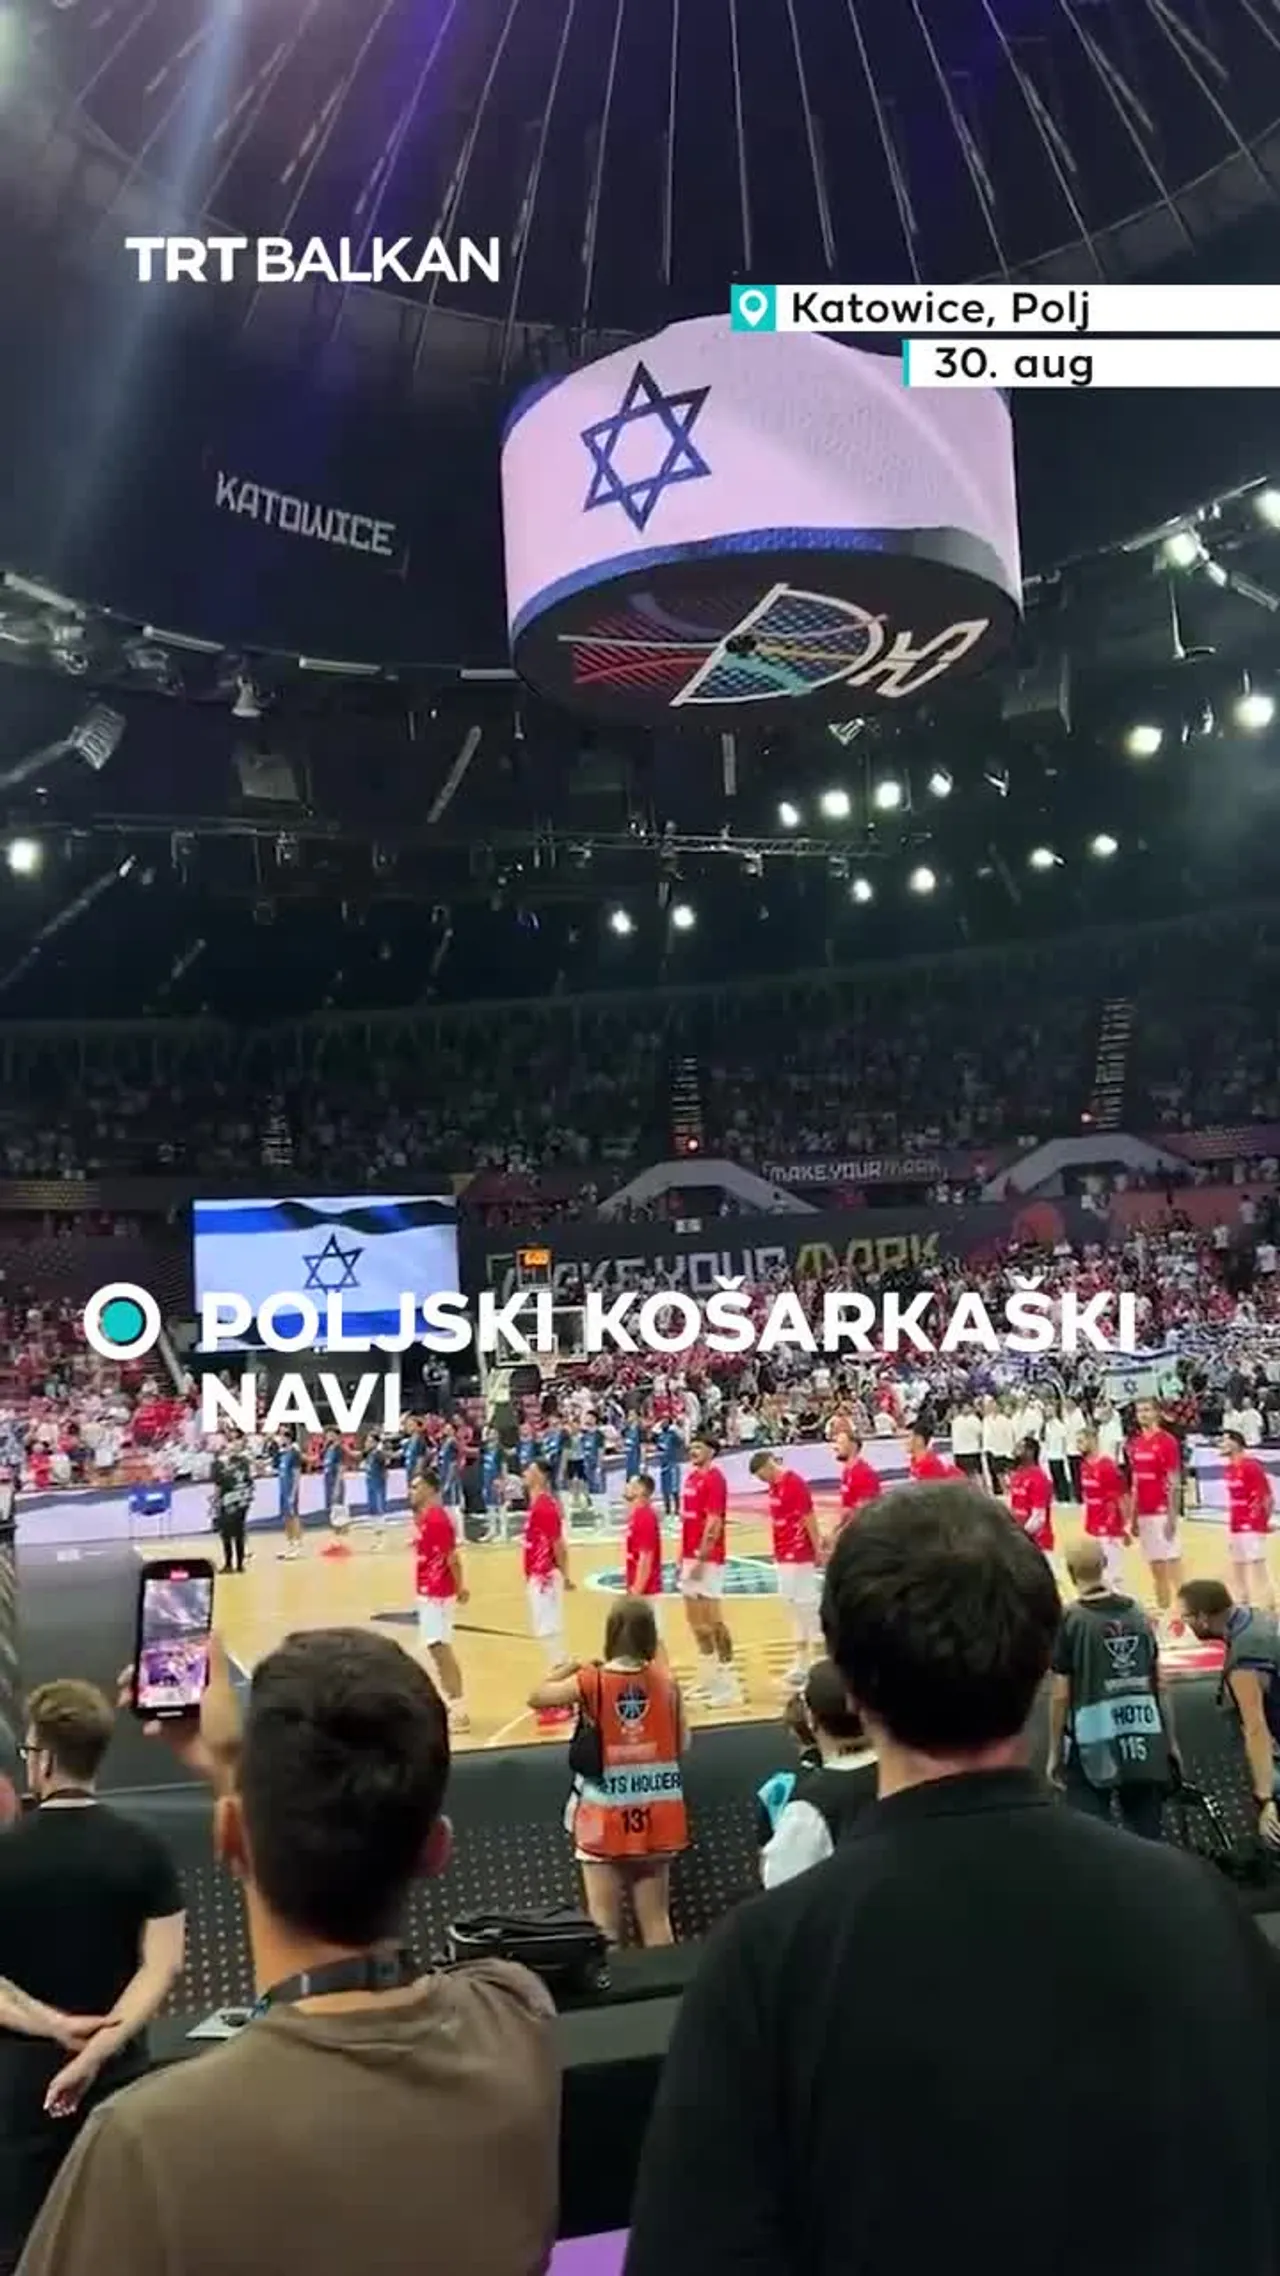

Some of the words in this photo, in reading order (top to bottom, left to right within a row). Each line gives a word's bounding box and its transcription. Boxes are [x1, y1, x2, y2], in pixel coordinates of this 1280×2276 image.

[215, 470, 396, 556] KATOWICE
[770, 1163, 827, 1183] MAKE
[1119, 1735, 1147, 1761] 115
